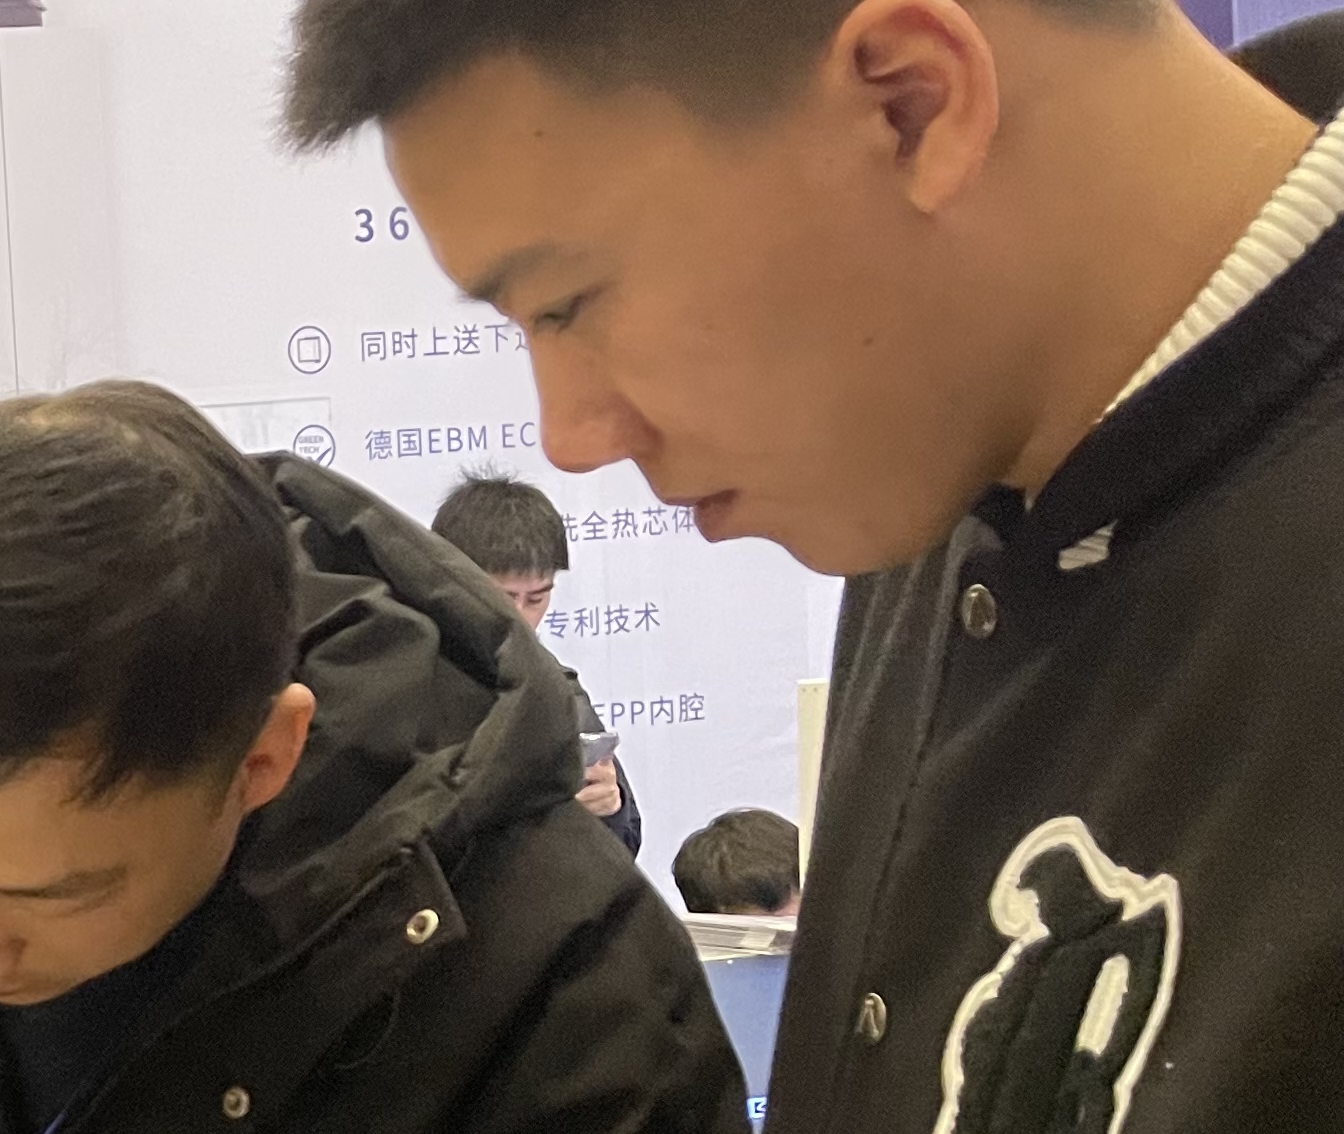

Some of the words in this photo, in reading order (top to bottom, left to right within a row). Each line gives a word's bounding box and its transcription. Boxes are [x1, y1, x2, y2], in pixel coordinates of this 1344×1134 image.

[365, 425, 488, 461] 德国EBM
[544, 602, 661, 639] 专利技术
